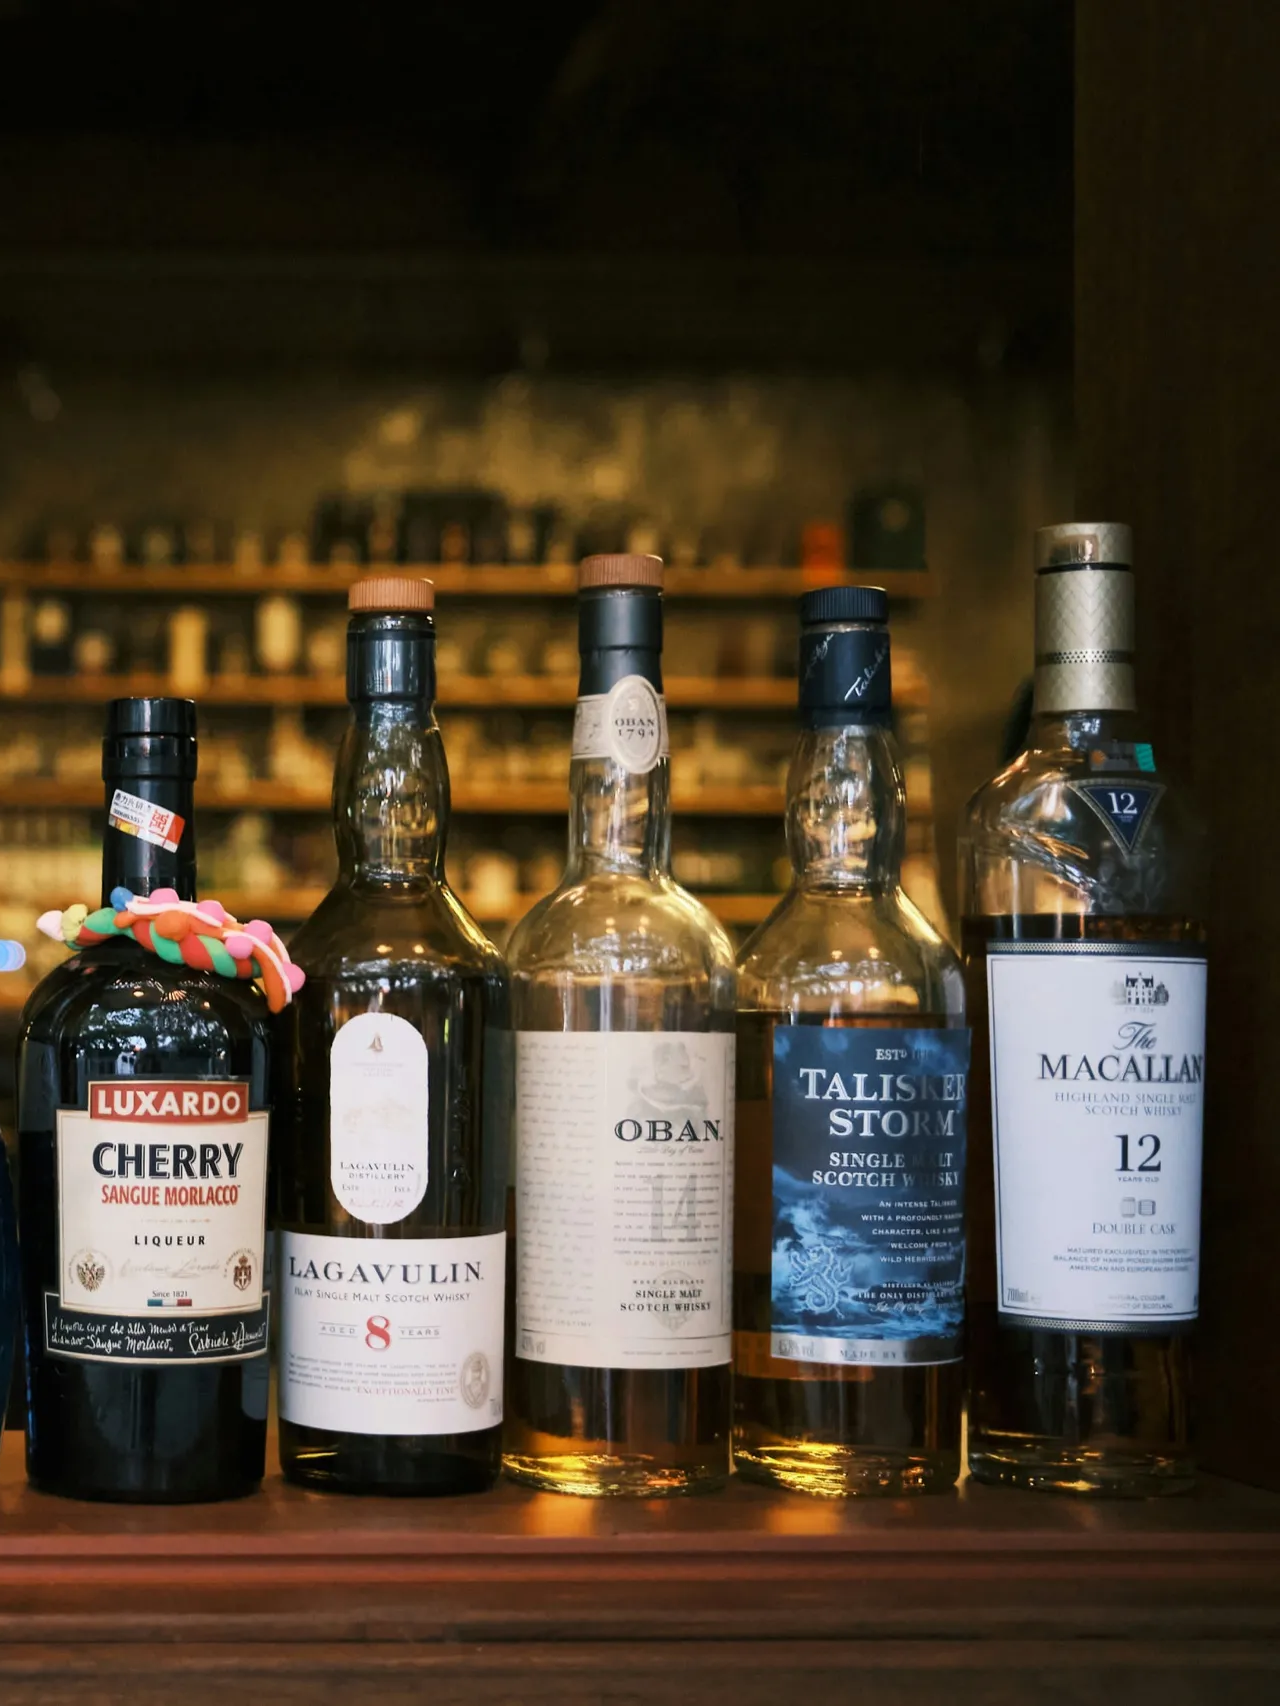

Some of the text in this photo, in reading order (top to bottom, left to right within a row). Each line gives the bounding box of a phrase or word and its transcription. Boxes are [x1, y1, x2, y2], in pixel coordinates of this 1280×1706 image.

[614, 718, 655, 727] OBAN
[617, 728, 655, 740] 1794
[1107, 791, 1138, 814] 12
[1112, 1021, 1157, 1051] The
[1036, 1053, 1204, 1084] MACALLAN
[799, 1068, 966, 1101] TALISKER
[97, 1090, 241, 1116] LUXARDO
[1054, 1092, 1130, 1102] HIGHLAND
[1135, 1092, 1176, 1103] SINGLE
[1084, 1105, 1183, 1116] SCOTCH WHISKY
[829, 1108, 955, 1137] STORM
[92, 1141, 244, 1179] CHERRY
[829, 1151, 905, 1168] SINGLE
[1115, 1134, 1162, 1173] 12
[340, 1161, 415, 1171] LAGAVULIN
[348, 1172, 406, 1180] DISTILLERY
[812, 1170, 896, 1187] SCOTCH
[101, 1184, 160, 1206] SANGUE
[878, 1200, 891, 1208] AN
[1092, 1222, 1178, 1235] DOUBLE CASK
[134, 1235, 206, 1247] LIQUEUR
[152, 1290, 188, 1298] Since 1821
[294, 1286, 471, 1303] ISLAY SINGLE MALT SCOTCH WHISKY
[635, 1289, 703, 1299] SINGLE MALT
[879, 1292, 904, 1300] ONLY
[620, 1302, 711, 1312] SCOTCH WHISKY
[320, 1314, 441, 1352] AGED 8 YEARS
